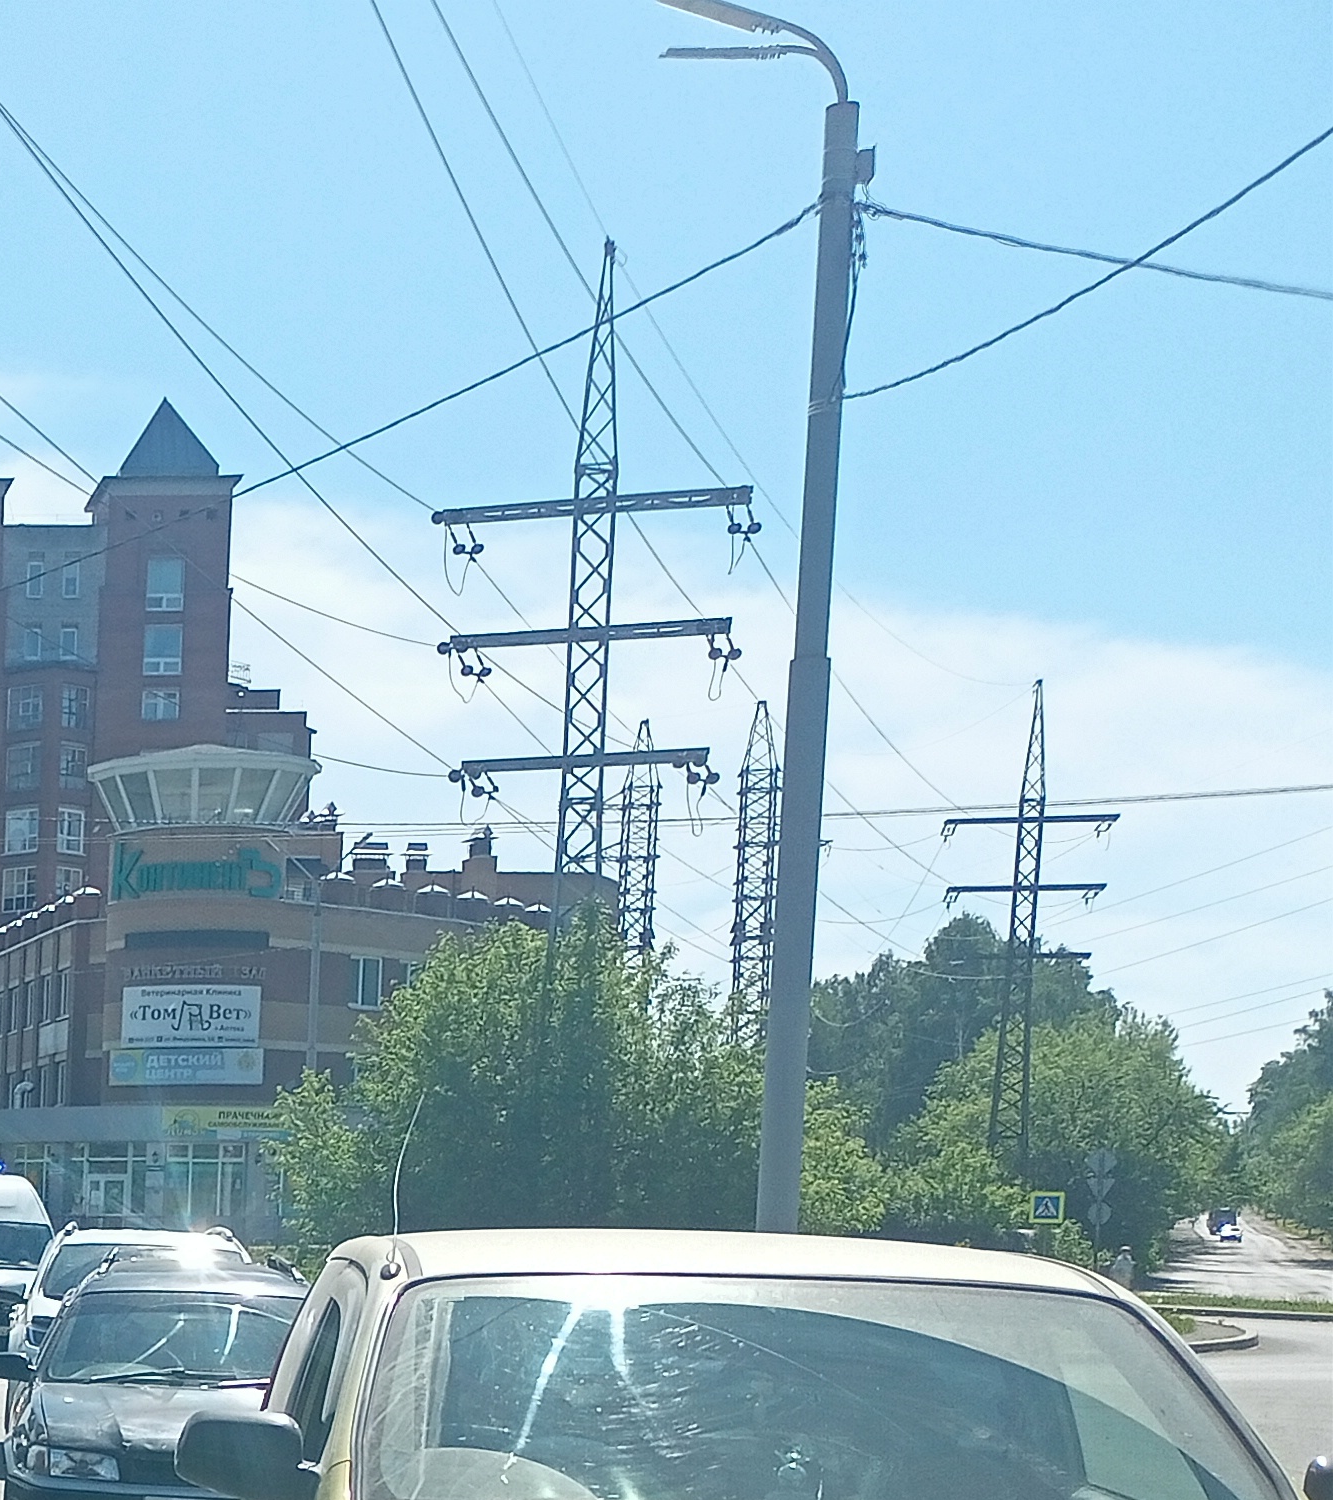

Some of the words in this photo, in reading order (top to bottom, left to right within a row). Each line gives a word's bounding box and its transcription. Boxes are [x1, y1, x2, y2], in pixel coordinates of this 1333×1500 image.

[205, 987, 242, 997] Клиника
[146, 1052, 222, 1068] ДЕТСКИЙ
[145, 1069, 192, 1080] ЦЕНТР
